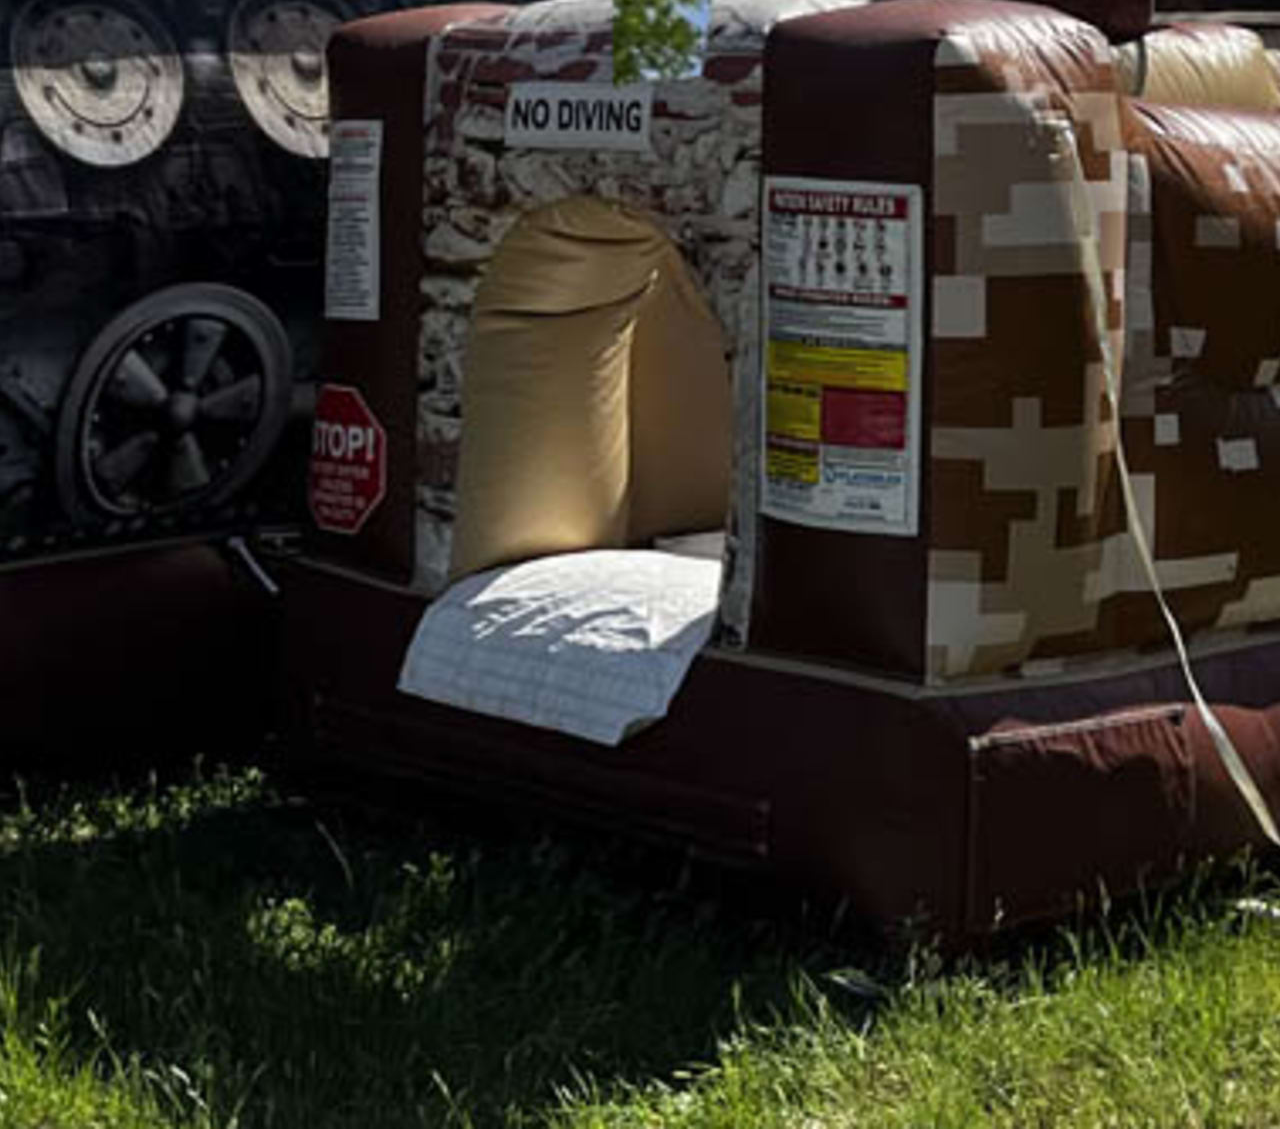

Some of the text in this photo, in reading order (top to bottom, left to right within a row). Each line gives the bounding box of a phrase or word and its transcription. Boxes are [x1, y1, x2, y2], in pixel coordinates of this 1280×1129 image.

[511, 99, 642, 132] NO DIVING
[807, 193, 850, 213] SAFETY
[852, 195, 896, 216] RULES
[312, 421, 375, 463] TOP!
